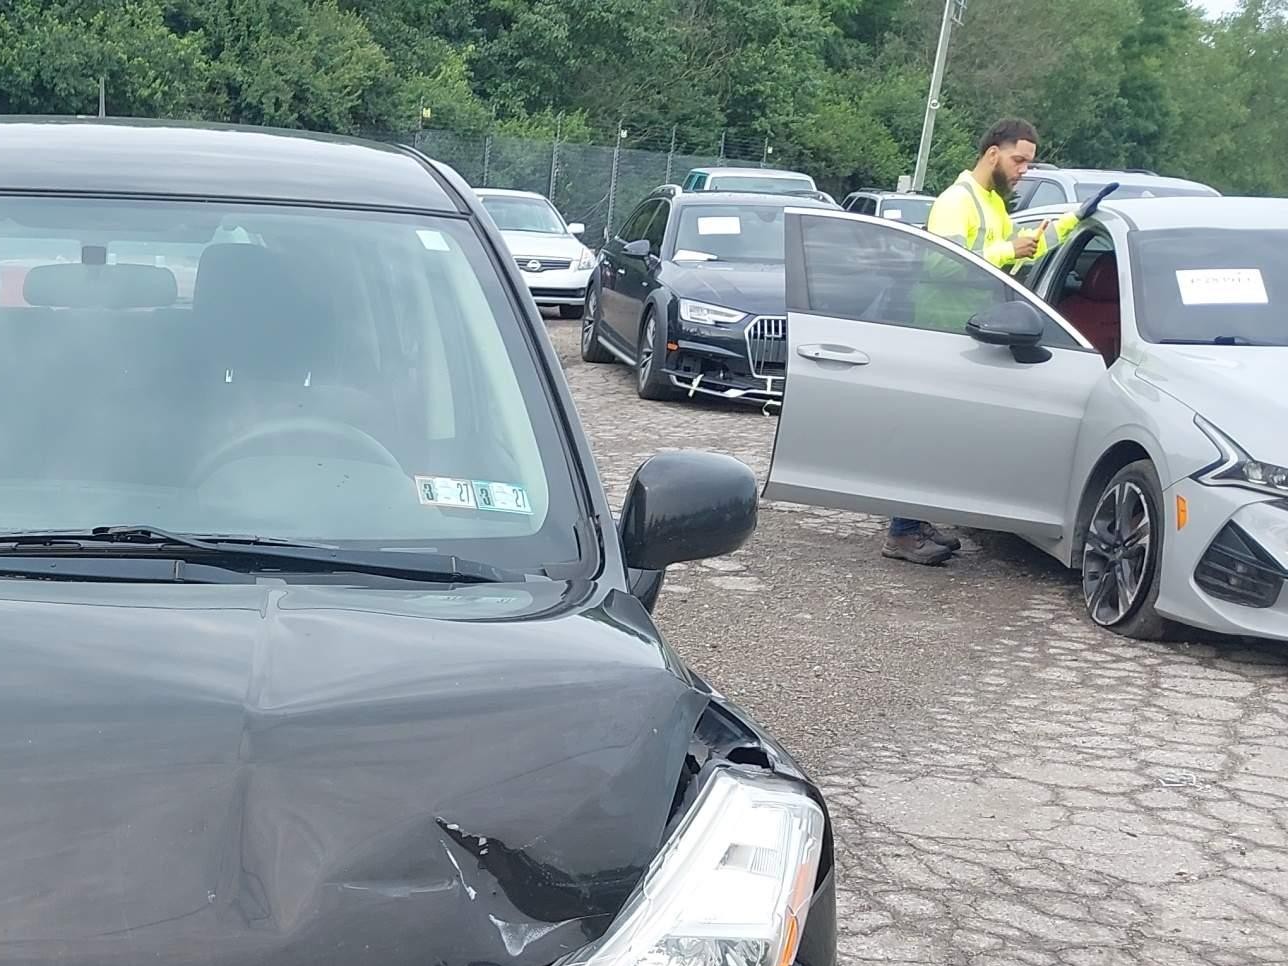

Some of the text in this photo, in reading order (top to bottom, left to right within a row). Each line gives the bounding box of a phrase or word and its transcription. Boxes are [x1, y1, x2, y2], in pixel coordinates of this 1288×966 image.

[423, 483, 470, 504] 3 27
[480, 487, 526, 509] 3 27
